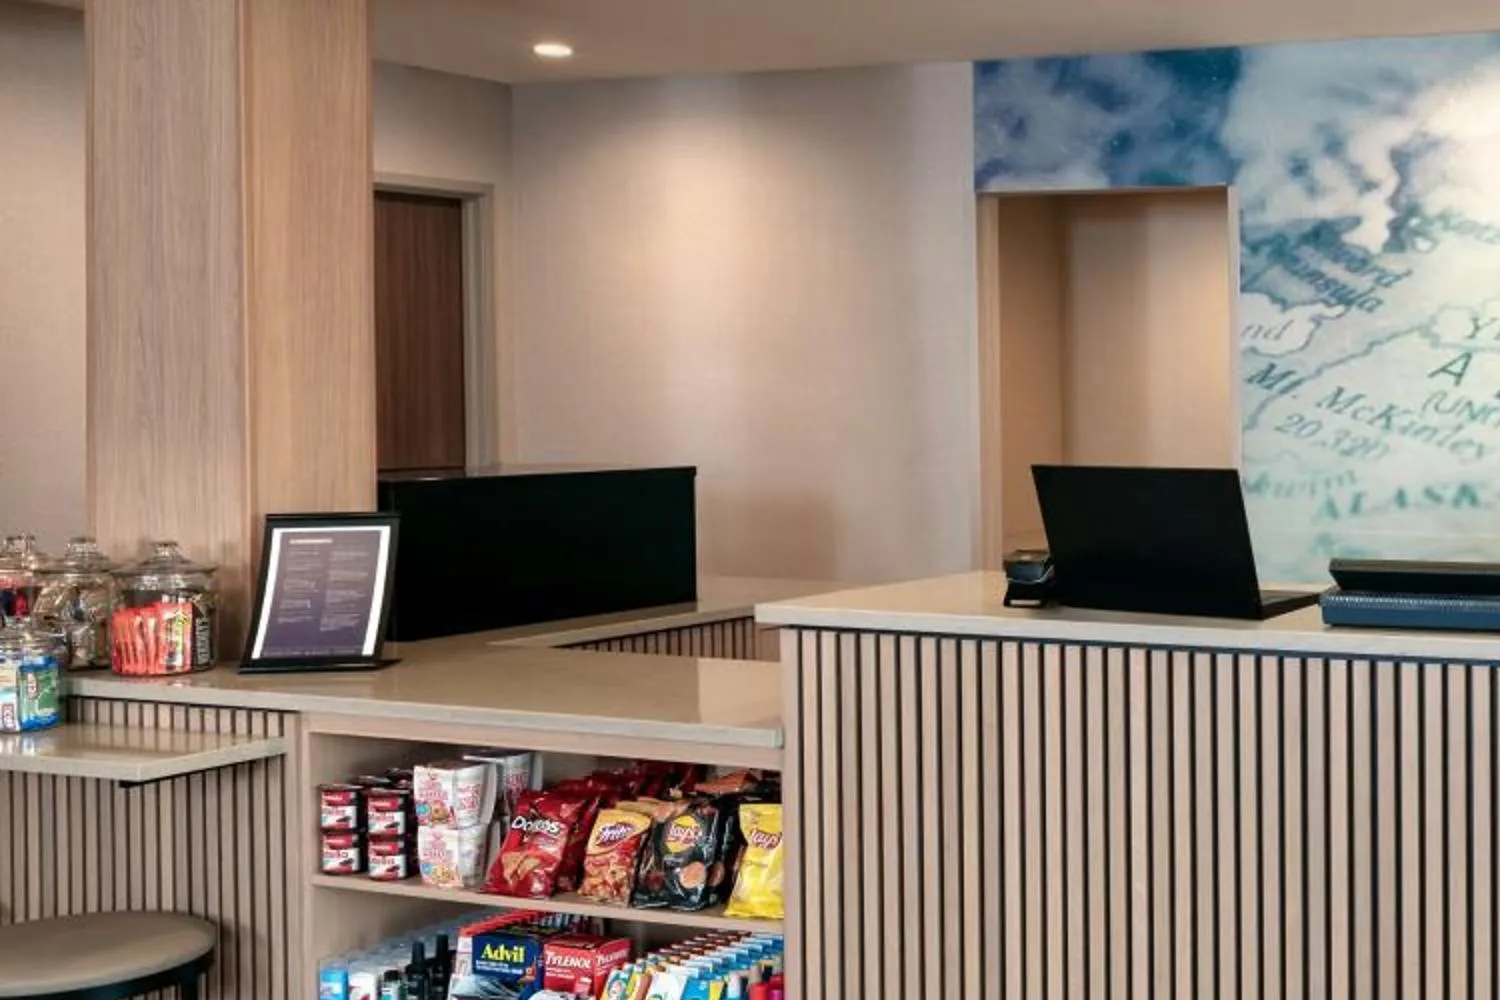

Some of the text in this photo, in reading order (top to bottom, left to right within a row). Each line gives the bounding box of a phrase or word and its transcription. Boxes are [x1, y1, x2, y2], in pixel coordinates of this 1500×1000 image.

[1314, 385, 1488, 464] McKinley
[511, 815, 561, 836] Doritos
[481, 943, 525, 963] Advil
[545, 950, 593, 969] TYLENOL
